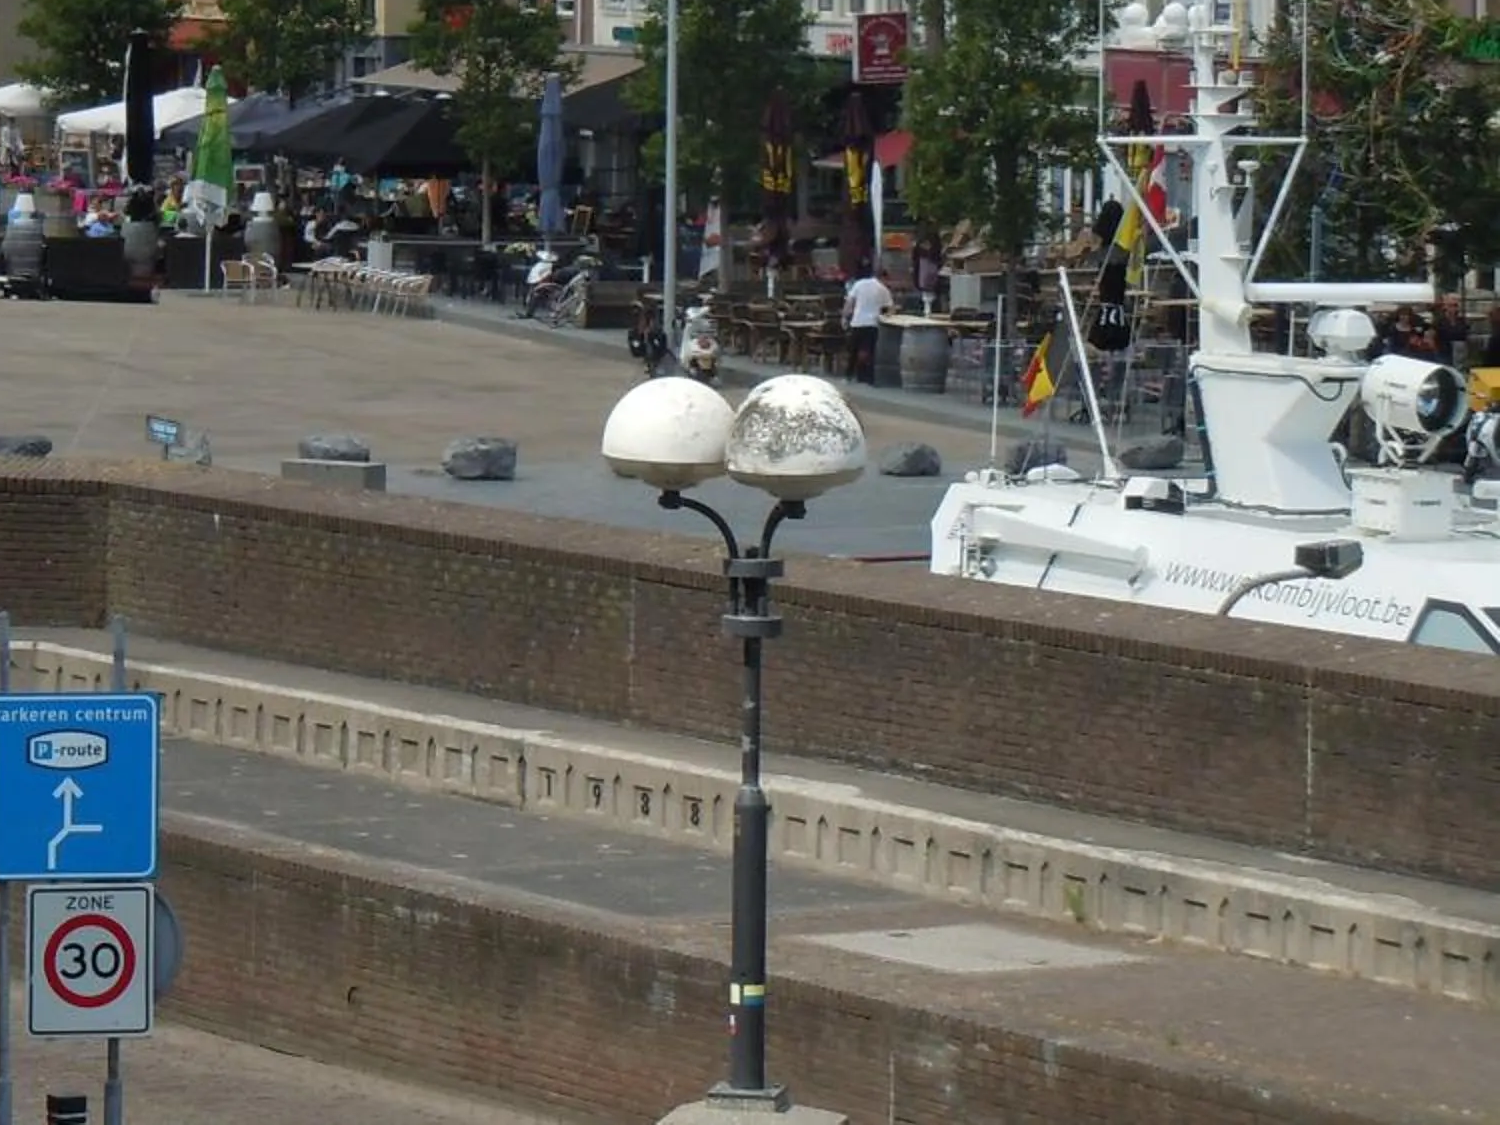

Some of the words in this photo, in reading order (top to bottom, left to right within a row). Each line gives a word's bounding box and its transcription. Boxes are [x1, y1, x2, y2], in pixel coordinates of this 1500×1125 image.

[75, 707, 149, 723] centrum
[65, 895, 115, 911] ZONE
[60, 942, 122, 980] 30
